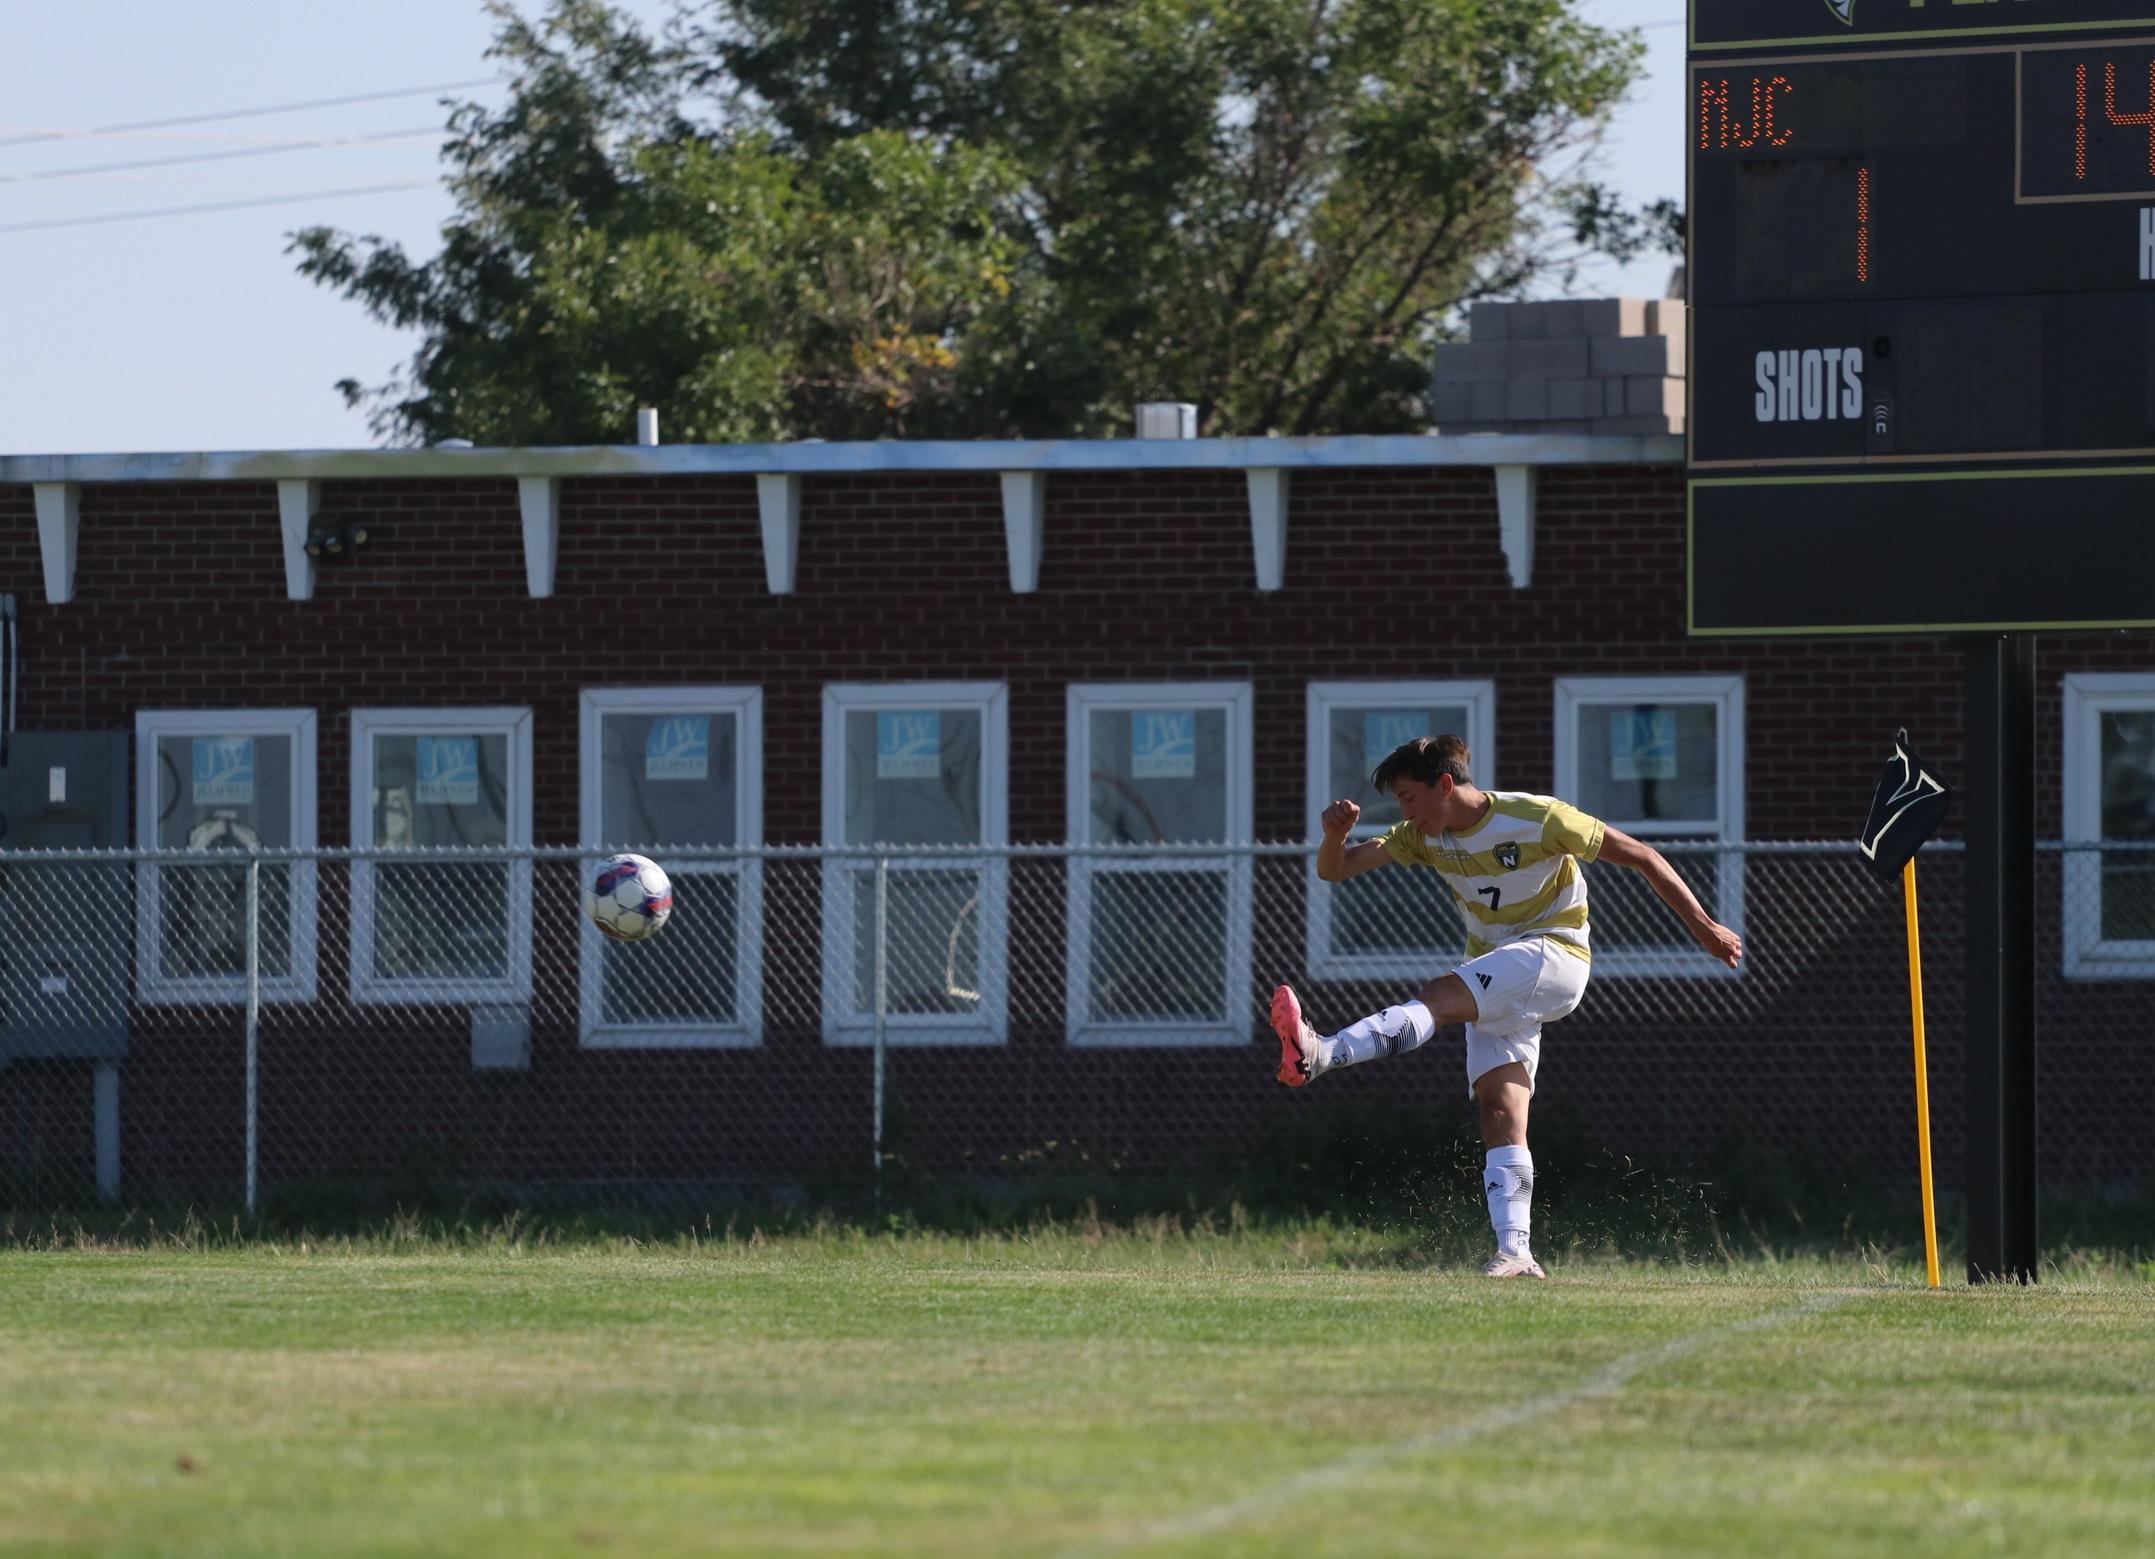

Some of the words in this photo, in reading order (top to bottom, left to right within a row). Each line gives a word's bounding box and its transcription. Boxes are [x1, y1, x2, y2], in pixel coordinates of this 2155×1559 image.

[1700, 76, 1794, 149] MJC
[1857, 167, 1869, 282] 1
[1755, 347, 1863, 422] SHOTS
[652, 719, 700, 754] JW
[882, 716, 930, 751] JW
[1137, 716, 1184, 751] JW
[199, 743, 246, 778] JW
[423, 742, 470, 778] JW
[1503, 855, 1516, 868] N
[1478, 886, 1501, 911] 7
